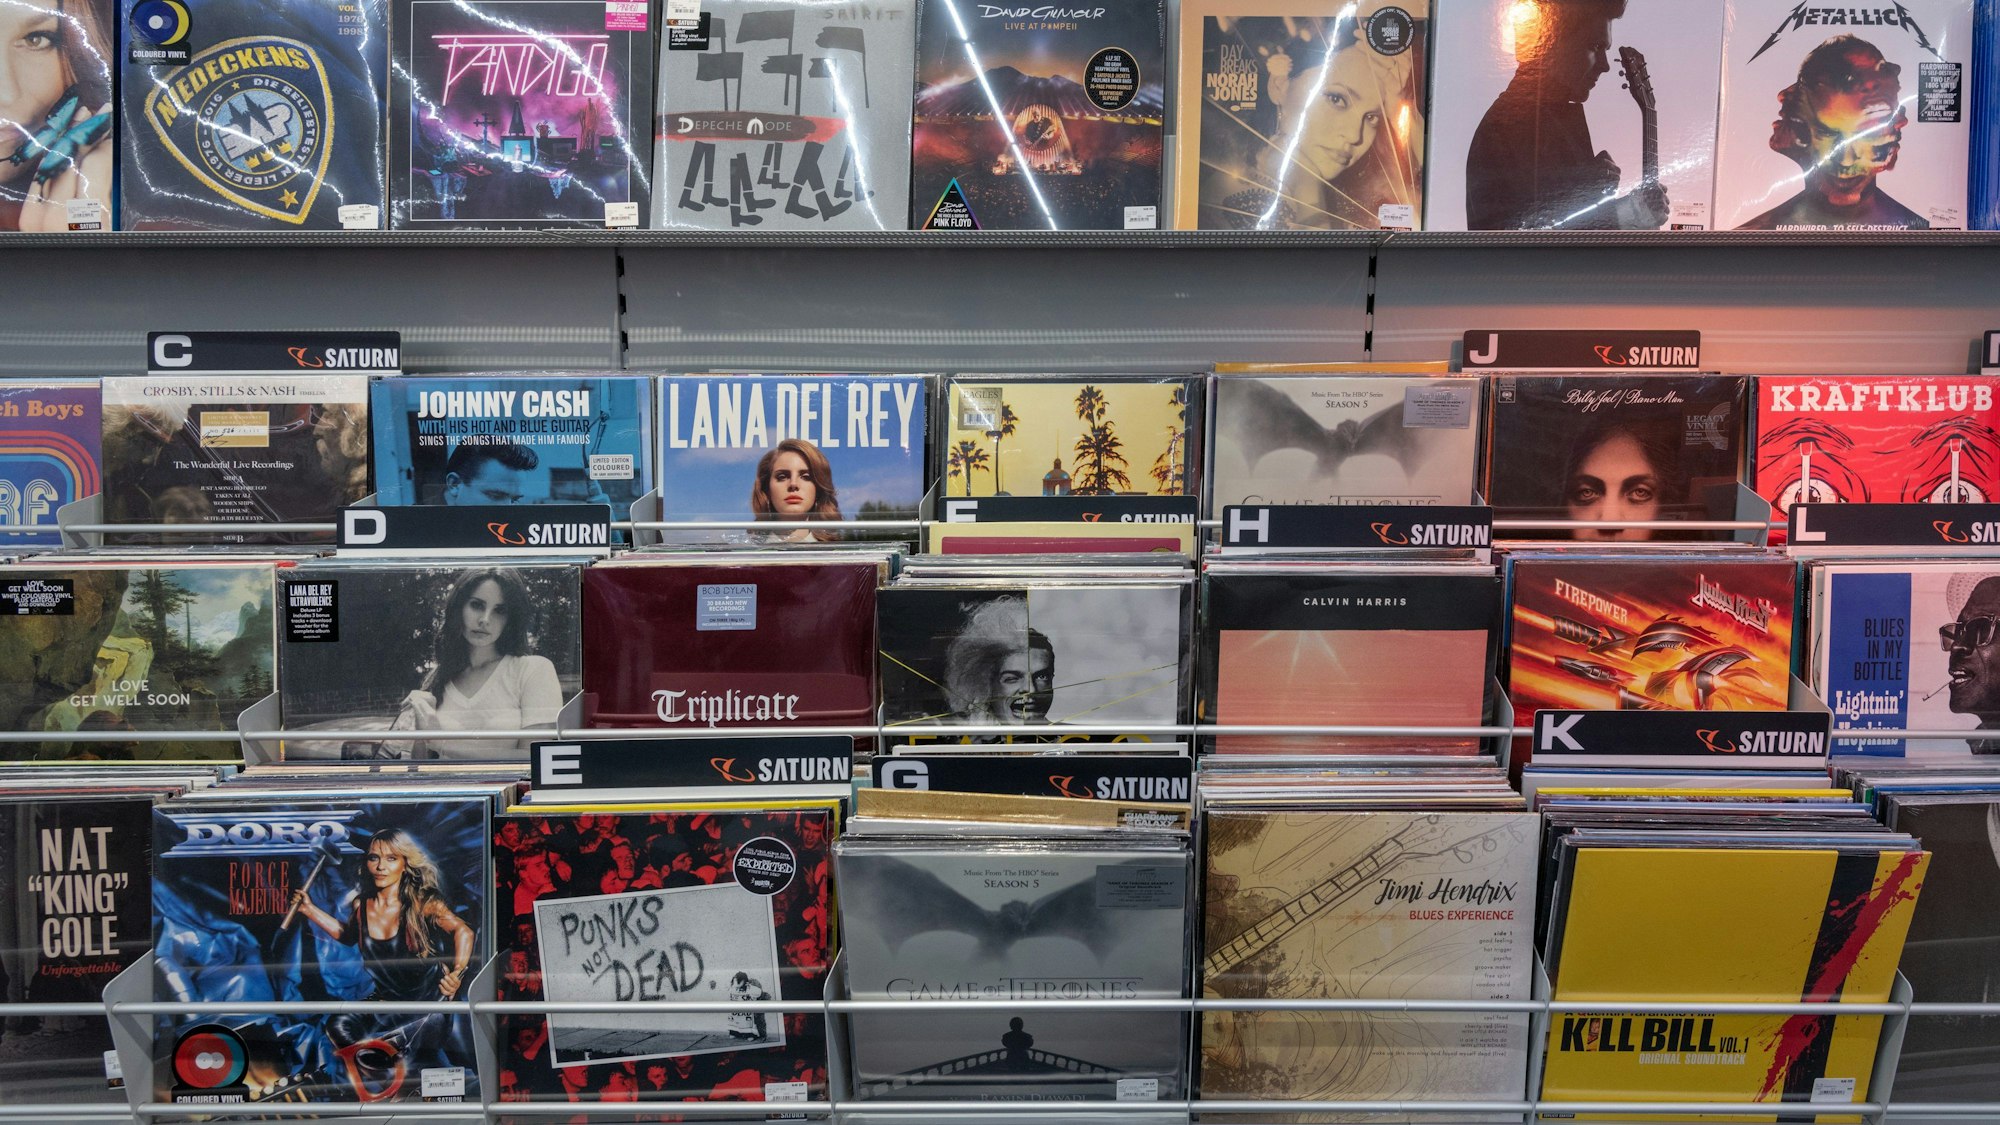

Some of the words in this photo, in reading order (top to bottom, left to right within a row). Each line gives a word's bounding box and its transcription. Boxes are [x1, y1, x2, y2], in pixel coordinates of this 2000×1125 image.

[823, 8, 902, 21] SPIRIT
[978, 4, 1031, 19] DAVID
[1031, 6, 1106, 20] GILMOUR
[1005, 22, 1026, 30] LIVE
[1028, 22, 1039, 30] AT
[1041, 22, 1078, 30] POMPEII
[133, 50, 166, 58] COLOURED
[168, 50, 187, 58] VINYL
[1221, 44, 1244, 60] DAY
[1220, 59, 1258, 74] BREAKS
[156, 46, 310, 127] NIEDECKENS
[253, 78, 279, 88] DIE
[1207, 73, 1258, 88] NORAH
[1210, 87, 1258, 101] JONES
[678, 117, 742, 134] DEPECHE
[746, 118, 792, 135] MODE
[224, 168, 277, 186] LIEDER
[934, 218, 950, 227] PINK
[951, 218, 972, 227] FLOYD
[154, 335, 192, 367] C
[325, 349, 397, 368] SATURN
[1469, 333, 1498, 364] J
[1629, 347, 1697, 366] SATURN
[143, 386, 198, 397] CROSBY,
[200, 386, 245, 396] STILLS
[247, 386, 257, 396] &
[260, 386, 295, 396] NASH
[1562, 389, 1595, 413] Billy
[1591, 390, 1617, 412] Joel
[1624, 390, 1655, 405] Piano
[1657, 391, 1684, 404] Man
[1771, 385, 1992, 412] KRAFTKLUB
[27, 400, 84, 420] Boys
[418, 391, 516, 418] JOHNNY
[522, 391, 590, 416] CASH
[1326, 400, 1359, 408] SEASON
[1361, 400, 1368, 408] 5
[670, 383, 768, 449] LANA
[777, 383, 839, 448] DEL
[848, 383, 917, 448] REY
[418, 420, 446, 434] WITH
[450, 420, 468, 434] HIS
[471, 420, 492, 434] HOT
[494, 420, 517, 434] AND
[520, 420, 548, 433] BLUE
[551, 420, 590, 433] GUITAR
[419, 435, 444, 446] SINGS
[445, 435, 460, 446] THE
[462, 435, 490, 446] SONGS
[491, 435, 510, 445] THAT
[512, 435, 536, 445] MADE
[538, 435, 555, 445] HIM
[556, 434, 590, 445] FAMOUS
[252, 461, 294, 470] Recordings
[344, 510, 386, 544] D
[528, 524, 607, 545] SATURN
[1229, 509, 1270, 543] H
[1410, 524, 1489, 545] SATURN
[1796, 507, 1826, 541] L
[290, 585, 307, 596] LANA
[308, 585, 319, 596] DEL
[320, 585, 332, 595] REY
[290, 596, 332, 606] ULTRAVIOLENCE
[1303, 598, 1350, 606] CALVIN
[1357, 598, 1407, 606] HARRIS
[1554, 578, 1628, 625] FIREPOWER
[1865, 618, 1904, 638] BLUES
[1868, 640, 1879, 659] IN
[1884, 640, 1903, 659] MY
[1854, 662, 1902, 681] BOTTLE
[112, 680, 149, 692] LOVE
[70, 695, 99, 707] GET
[103, 695, 142, 706] WELL
[147, 693, 190, 706] SOON
[651, 689, 800, 728] Triplicate
[1835, 690, 1903, 720] Lightnin'
[1541, 714, 1585, 750] K
[1739, 731, 1824, 754] SATURN
[540, 745, 582, 785] E
[758, 757, 848, 781] SATURN
[881, 760, 929, 790] G
[1097, 777, 1188, 800] SATURN
[1124, 812, 1179, 821] GUARDIANS
[182, 821, 350, 845] DORO
[42, 827, 113, 872] NAT
[229, 861, 290, 889] FORCE
[737, 857, 793, 874] EXPLOITED
[984, 879, 1029, 889] SEASON
[1032, 879, 1040, 889] 5
[1375, 878, 1424, 905] Jimi
[1428, 878, 1518, 905] Hendrix
[28, 873, 128, 915] “KING”
[229, 888, 290, 916] MAJEURE
[1409, 910, 1444, 920] BLUES
[1447, 910, 1514, 920] EXPERIENCE
[560, 895, 664, 956] PUNKS
[42, 916, 120, 958] COLE
[41, 962, 122, 978] Unforgettable
[581, 944, 613, 979] NOT
[592, 941, 716, 1001] DEAD.
[886, 978, 978, 1001] GAME
[984, 984, 1006, 997] OF
[1000, 977, 1143, 1001] THRONES
[1560, 1018, 1634, 1052] KILL
[1641, 1018, 1716, 1052] BILL
[1720, 1037, 1741, 1053] VOL.
[1744, 1037, 1749, 1053] 1
[1639, 1054, 1681, 1065] ORIGINAL
[1685, 1054, 1745, 1065] SOUNDTRACK
[176, 1095, 219, 1103] COLOURED
[221, 1095, 245, 1103] VINYL
